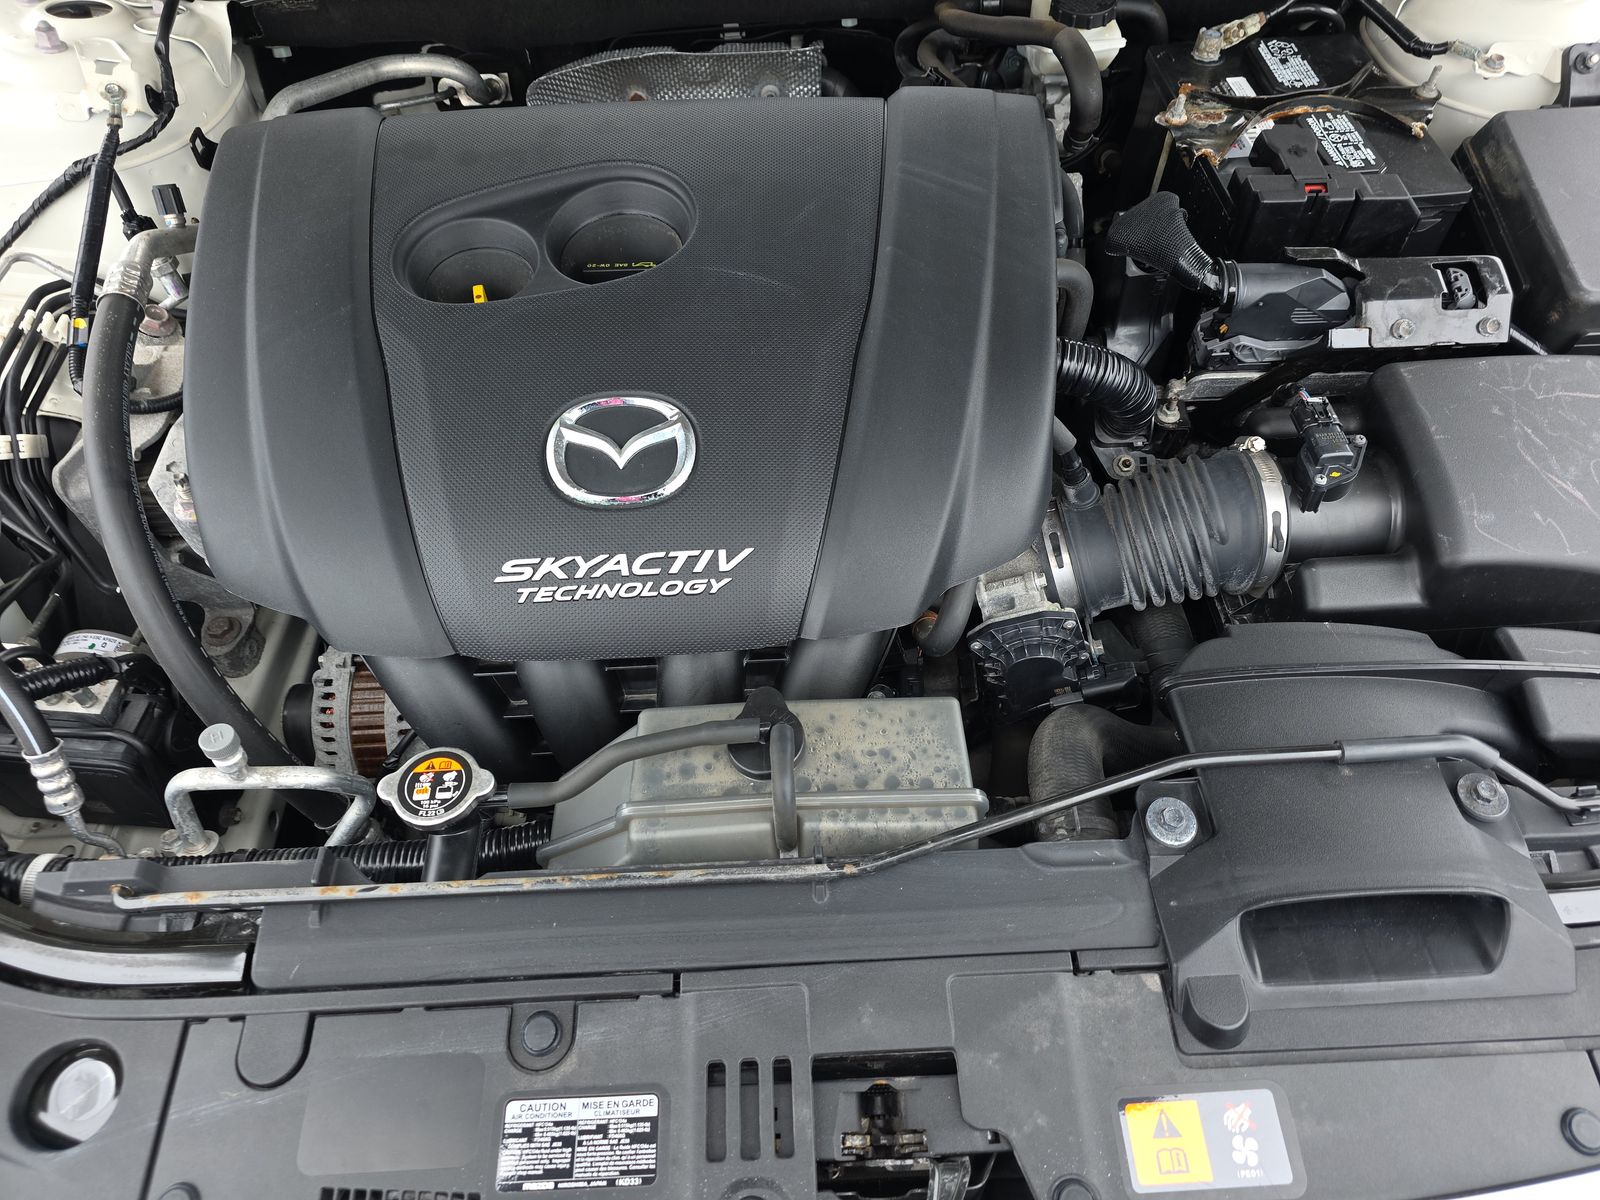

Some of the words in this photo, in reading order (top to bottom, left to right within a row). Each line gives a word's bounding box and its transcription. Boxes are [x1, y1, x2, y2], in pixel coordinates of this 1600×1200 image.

[493, 548, 755, 583] SKYACTIV
[516, 577, 733, 604] TECHNOLOGY
[520, 1102, 567, 1112] CAUTION
[582, 1101, 604, 1110] MISE
[606, 1100, 620, 1109] EN
[621, 1098, 655, 1108] GARDE
[524, 1111, 573, 1119] CONDITIONER
[593, 1108, 641, 1117] CLIMATISEUR
